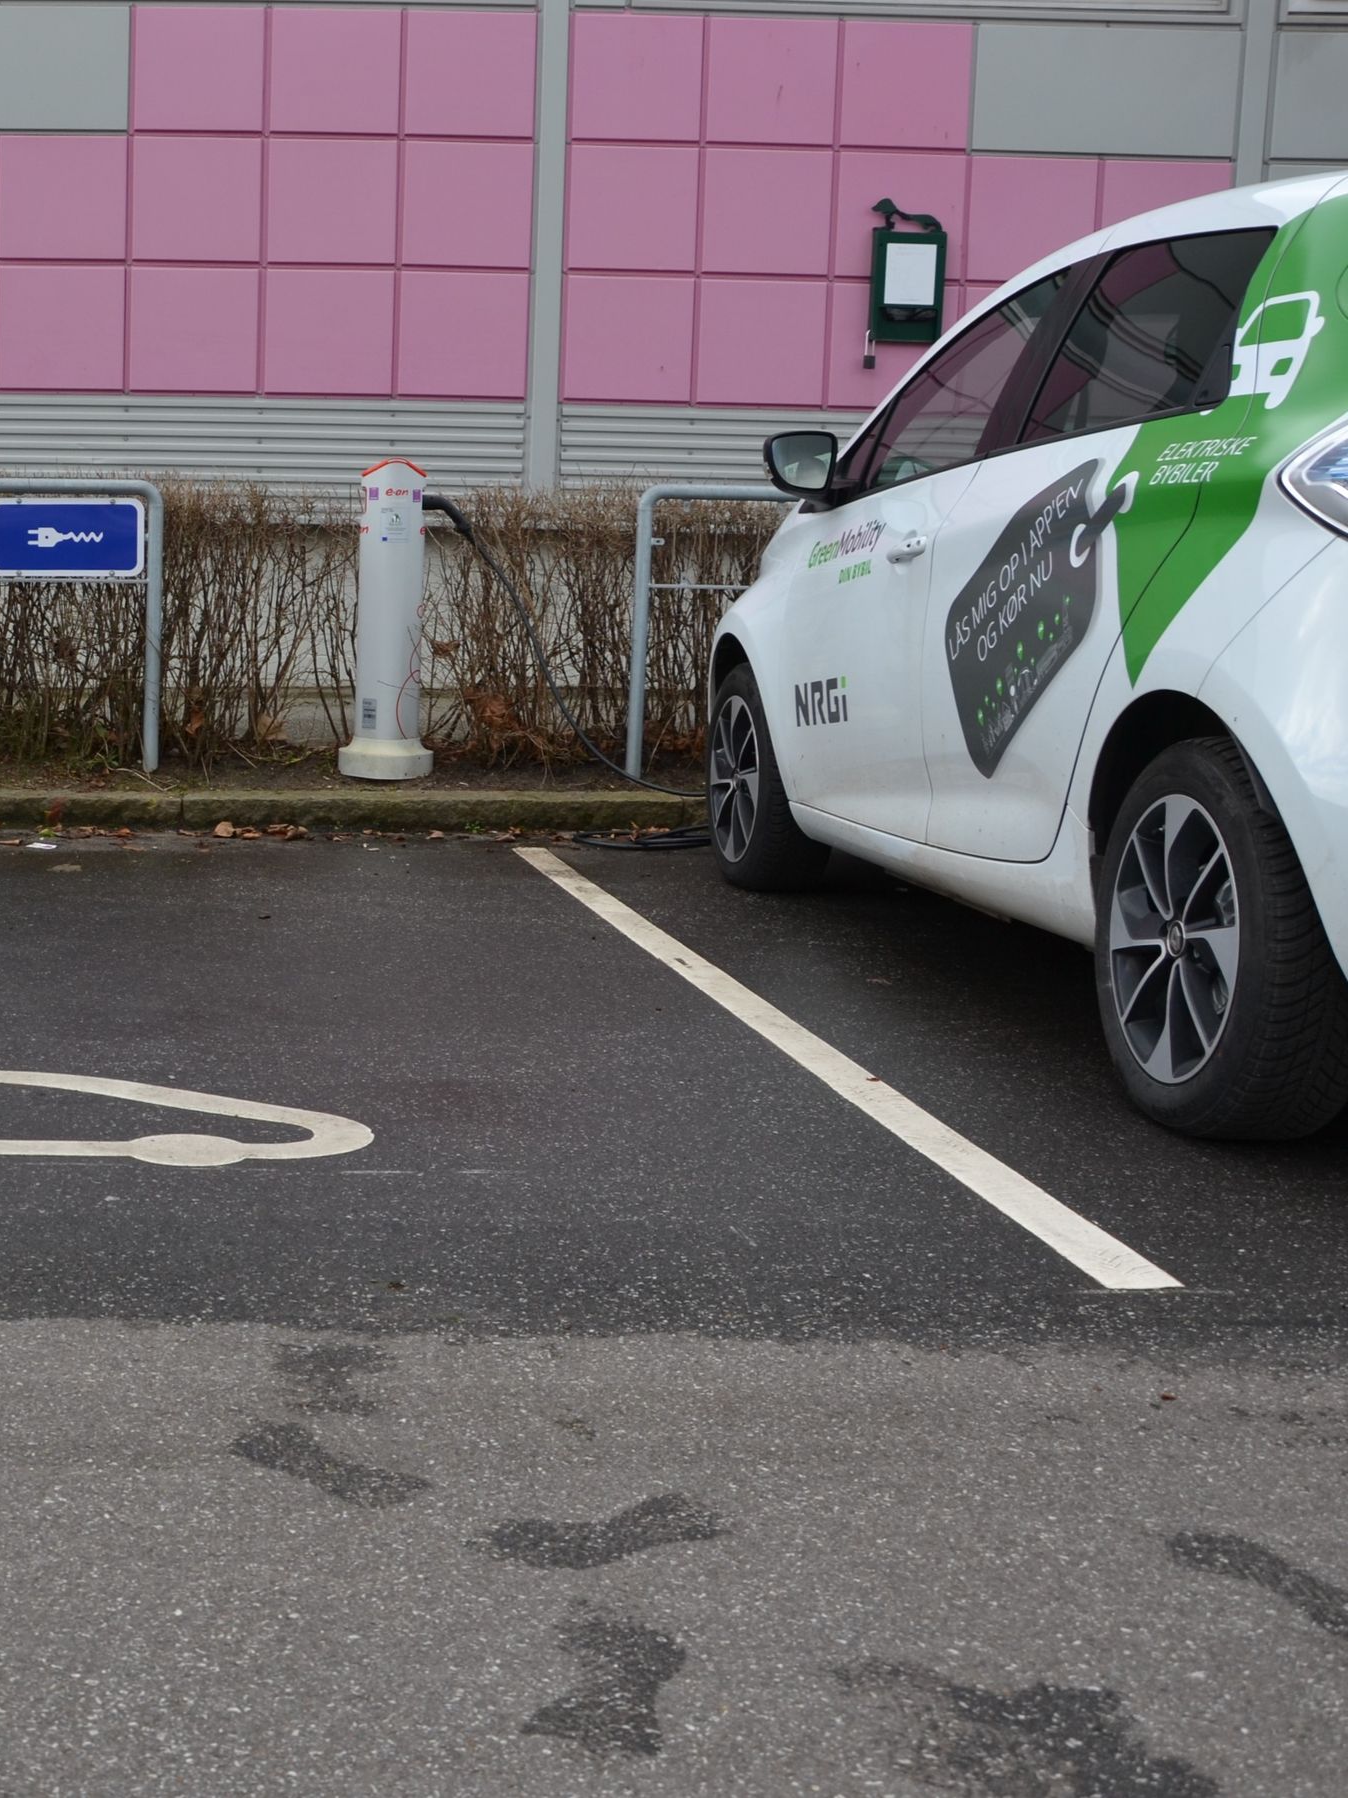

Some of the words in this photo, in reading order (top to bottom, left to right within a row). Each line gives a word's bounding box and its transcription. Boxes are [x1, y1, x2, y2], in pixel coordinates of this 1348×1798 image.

[1148, 461, 1220, 485] BYBILER
[1156, 436, 1258, 462] ELEKTRISKE
[808, 519, 887, 569] GreenMobility
[948, 615, 971, 660] LÅS
[971, 580, 998, 629] MIG
[999, 552, 1019, 592] OP
[1021, 541, 1028, 566] I
[1029, 478, 1084, 558] APP'EN
[977, 620, 998, 662] OG
[998, 583, 1028, 635] KØR
[1029, 551, 1052, 597] NU
[794, 676, 848, 727] NRGi
